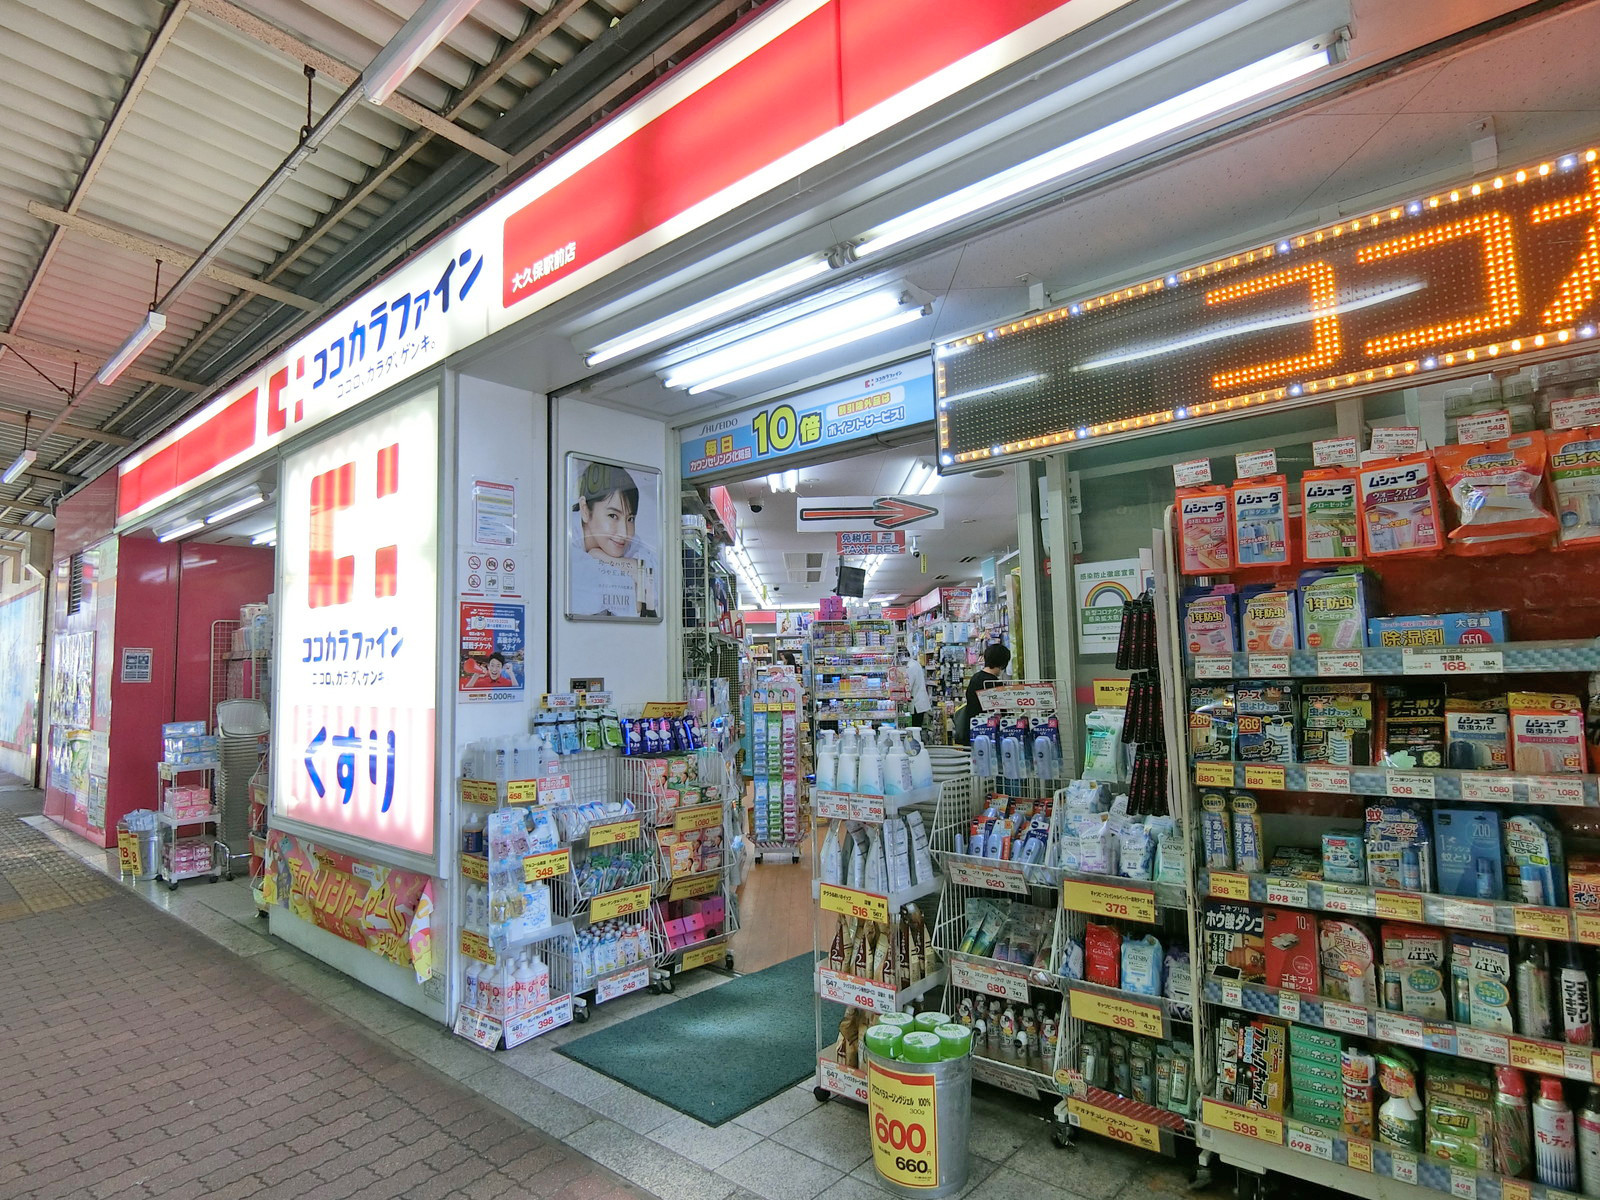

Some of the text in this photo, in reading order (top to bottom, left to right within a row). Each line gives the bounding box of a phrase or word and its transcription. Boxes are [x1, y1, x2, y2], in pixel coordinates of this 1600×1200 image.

[511, 241, 577, 293] 大久保駅前店
[312, 248, 484, 390] ココカラファイン
[699, 418, 738, 436] SHISEIDO
[1461, 459, 1524, 471] ドライペット
[1369, 470, 1419, 488] ムシューダ
[1307, 484, 1355, 497] ムシューダ
[1237, 491, 1282, 505] ムシューダ
[1183, 500, 1226, 514] ムシューダ
[841, 533, 872, 544] 免税店
[842, 545, 865, 554] TAX
[1080, 569, 1134, 580] 感染防止徹底宣言
[603, 594, 629, 606] ELIXIR
[1305, 597, 1353, 611] 1年防虫
[1188, 611, 1223, 623] 1年防虫
[1249, 608, 1285, 620] 1年防虫
[1456, 617, 1491, 628] 大容量
[1381, 629, 1444, 647] 除湿剤
[302, 626, 404, 663] ココカラファイン
[1191, 688, 1209, 696] アース
[1238, 690, 1261, 700] アース
[1017, 698, 1035, 706] 620
[1309, 696, 1333, 706] アース
[1457, 716, 1496, 725] ムシューダ
[1525, 719, 1568, 728] ムシューダ
[304, 726, 396, 813] くすり
[1366, 807, 1383, 822] 蚊
[1243, 823, 1254, 853] あみ戸
[1441, 853, 1471, 863] 蚊とり
[536, 867, 553, 878] 348
[986, 879, 1005, 888] 620
[1269, 894, 1289, 903] 898
[618, 903, 633, 913] 228
[852, 905, 868, 917] 516
[1105, 903, 1127, 915] 378
[1220, 904, 1249, 914] ゴキブリ用
[1206, 911, 1264, 932] ホウ酸ダンゴ
[1128, 954, 1148, 962] GATSBY
[1281, 974, 1313, 985] ゴキブリ
[623, 981, 636, 991] 248
[986, 983, 1006, 994] 680
[855, 995, 874, 1007] 498
[538, 1016, 554, 1029] 398
[1112, 1015, 1135, 1028] 398
[1225, 1109, 1258, 1122] ブラックキャップ
[1108, 1126, 1133, 1141] 900
[1233, 1120, 1258, 1136] 598
[1291, 1139, 1312, 1152] 698
